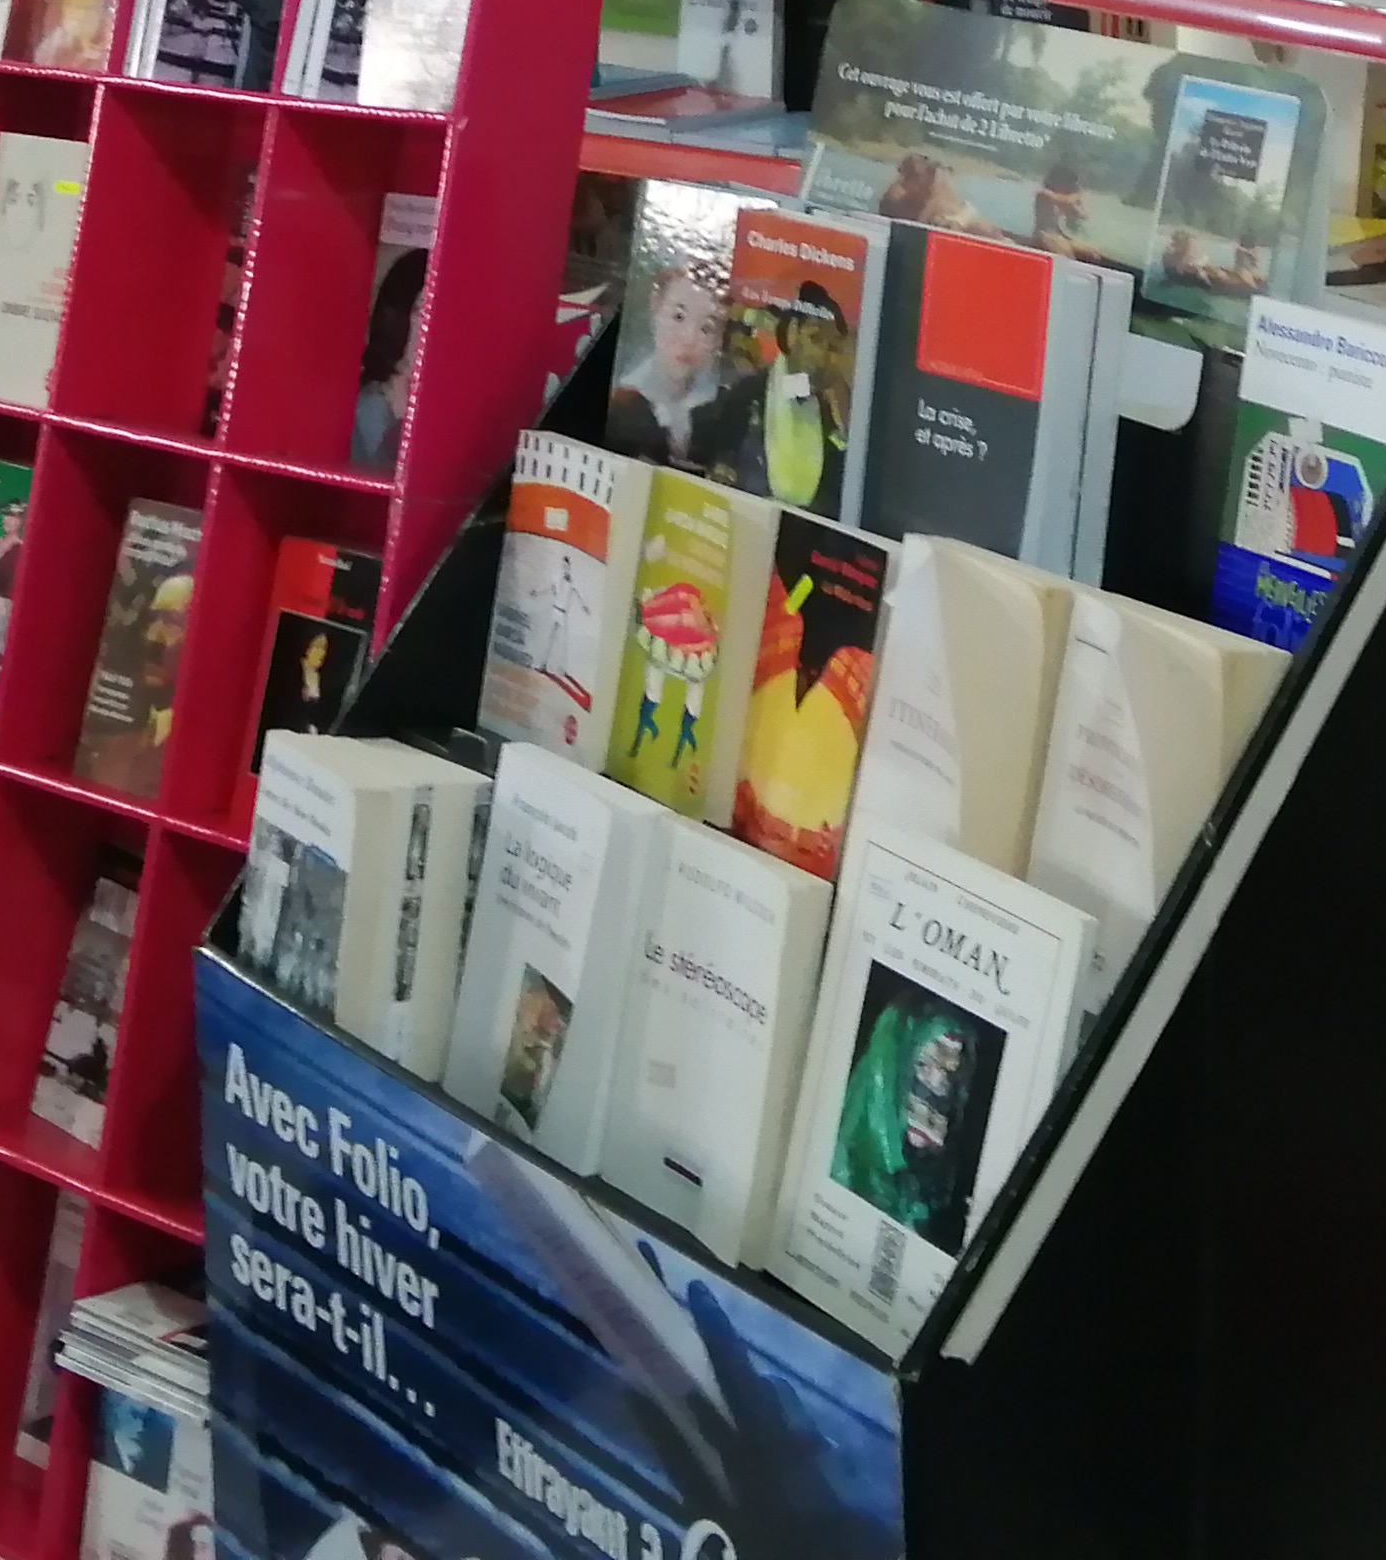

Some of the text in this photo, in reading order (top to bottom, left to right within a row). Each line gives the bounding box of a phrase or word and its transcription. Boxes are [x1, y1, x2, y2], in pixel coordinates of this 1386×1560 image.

[837, 62, 860, 83] Cet
[860, 70, 912, 97] ouvrage
[912, 82, 941, 100] vous
[941, 88, 962, 105] est
[962, 90, 1000, 114] offert
[883, 100, 916, 120] pour
[915, 102, 960, 130] l'achat
[959, 114, 979, 134] de
[747, 229, 855, 272] Charles Dickens
[1258, 313, 1334, 351] Alessandro
[917, 397, 977, 437] La crise,
[914, 427, 990, 462] et après ?
[643, 929, 768, 1028] Le stéréoscope
[223, 1041, 442, 1252] Avec Folio,
[226, 1141, 441, 1329] votre hiver
